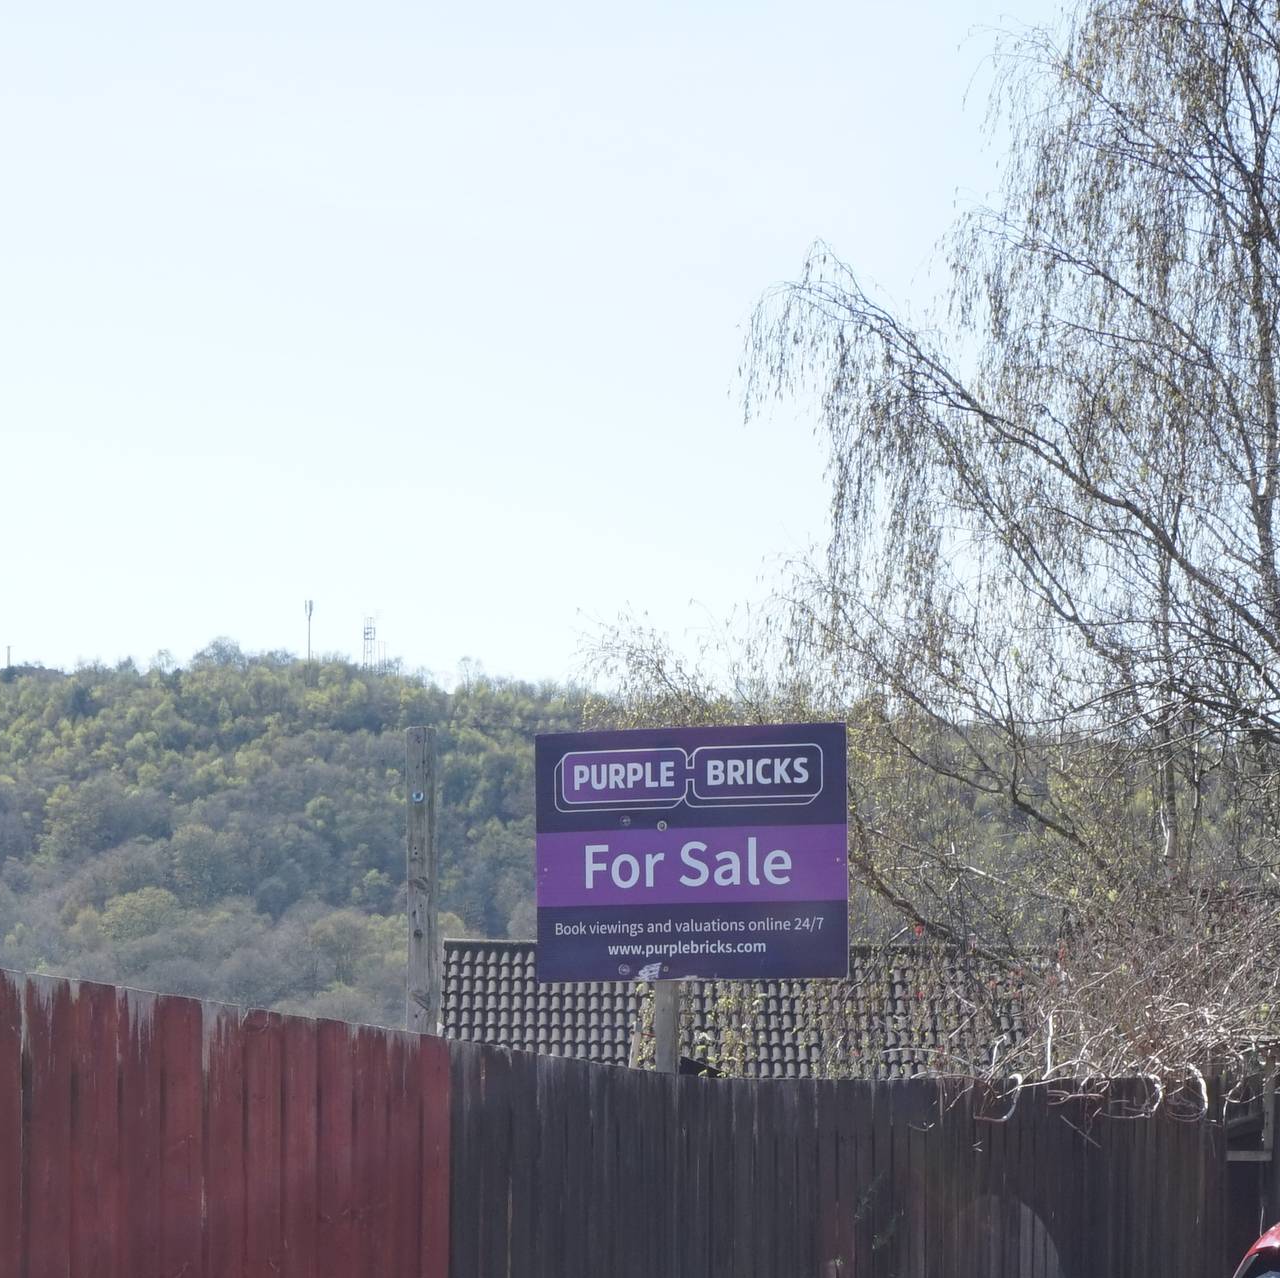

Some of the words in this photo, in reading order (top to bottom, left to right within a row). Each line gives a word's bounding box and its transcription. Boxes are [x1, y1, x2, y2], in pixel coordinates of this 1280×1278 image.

[573, 761, 675, 790] PURPLE
[707, 758, 809, 785] BRICKS
[585, 845, 664, 889] For
[679, 837, 792, 887] Sale
[555, 923, 586, 936] Book
[589, 921, 644, 937] viewings
[647, 920, 671, 933] and
[675, 918, 745, 933] valuations
[748, 918, 792, 931] online
[794, 917, 824, 932] 24/7
[608, 941, 766, 957] www.purplebricks.com
